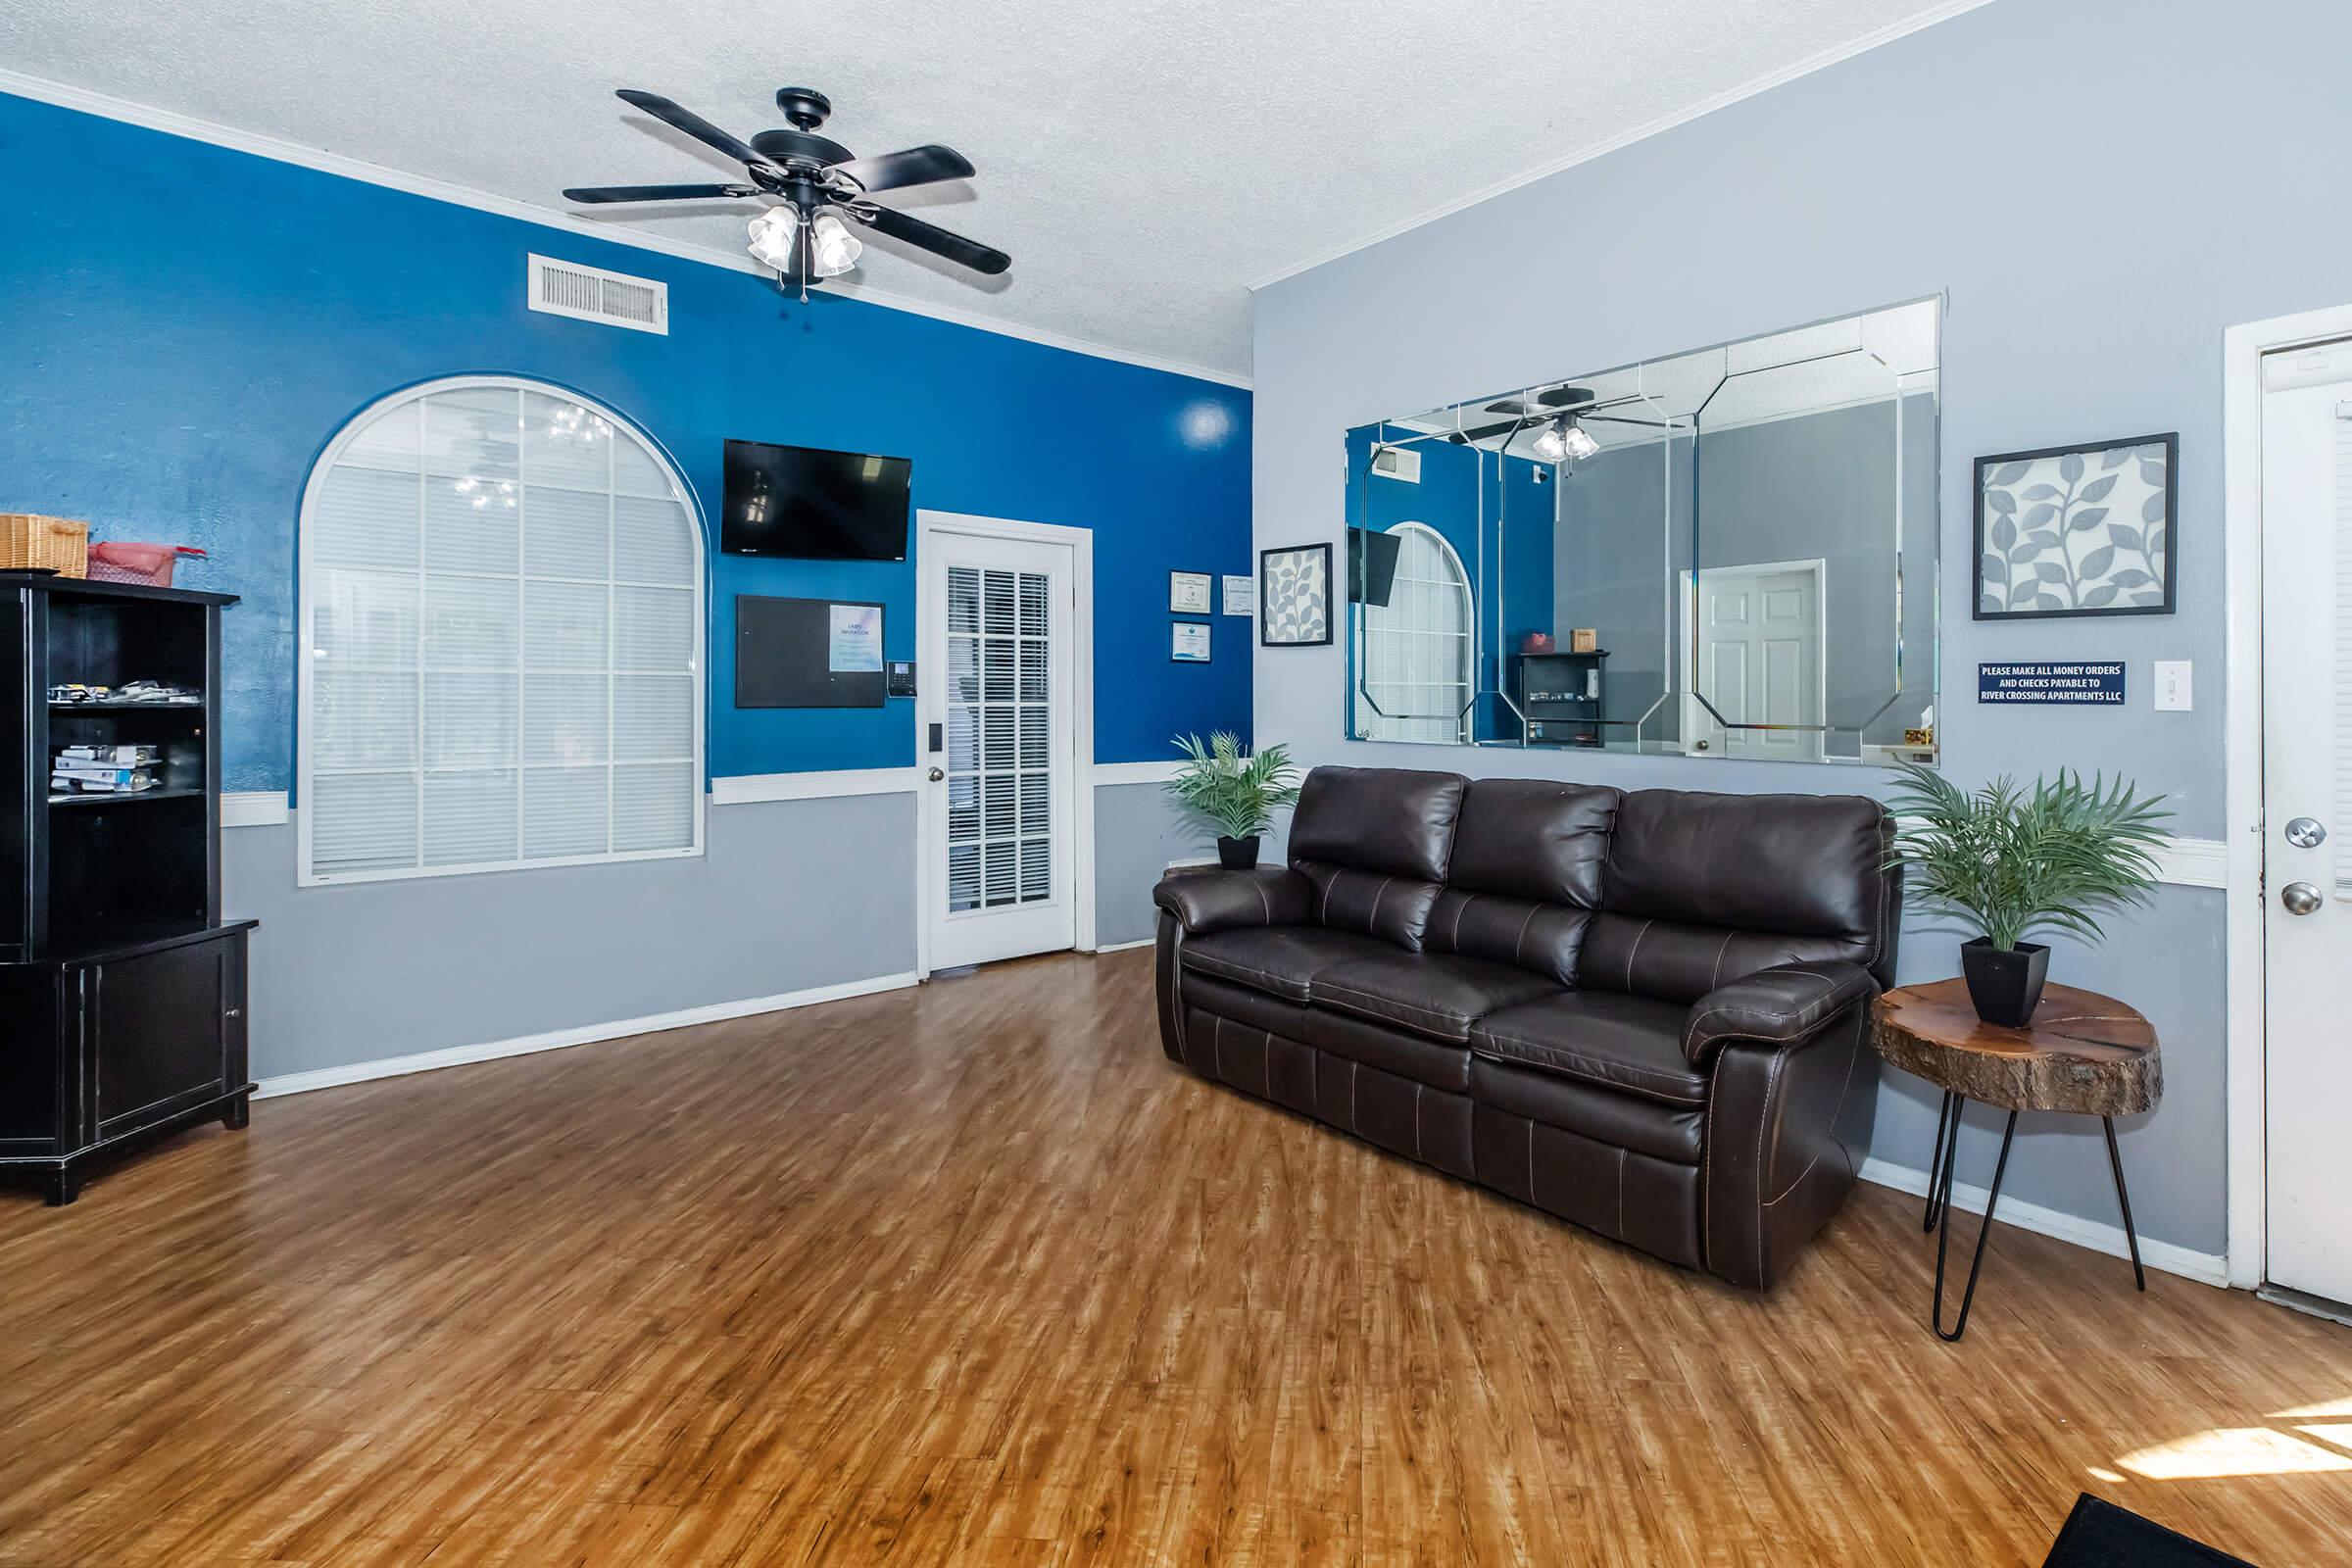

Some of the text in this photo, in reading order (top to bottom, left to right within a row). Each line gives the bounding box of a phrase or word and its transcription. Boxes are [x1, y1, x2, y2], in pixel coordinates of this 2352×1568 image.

[1982, 665, 2121, 675] PLEASE MAKE ALL MONEY ORDERS
[1999, 678, 2100, 688] AND CHECKS PAYABLE TO
[1981, 691, 2122, 701] RIVER CROSSING APARTMENTS LLC
